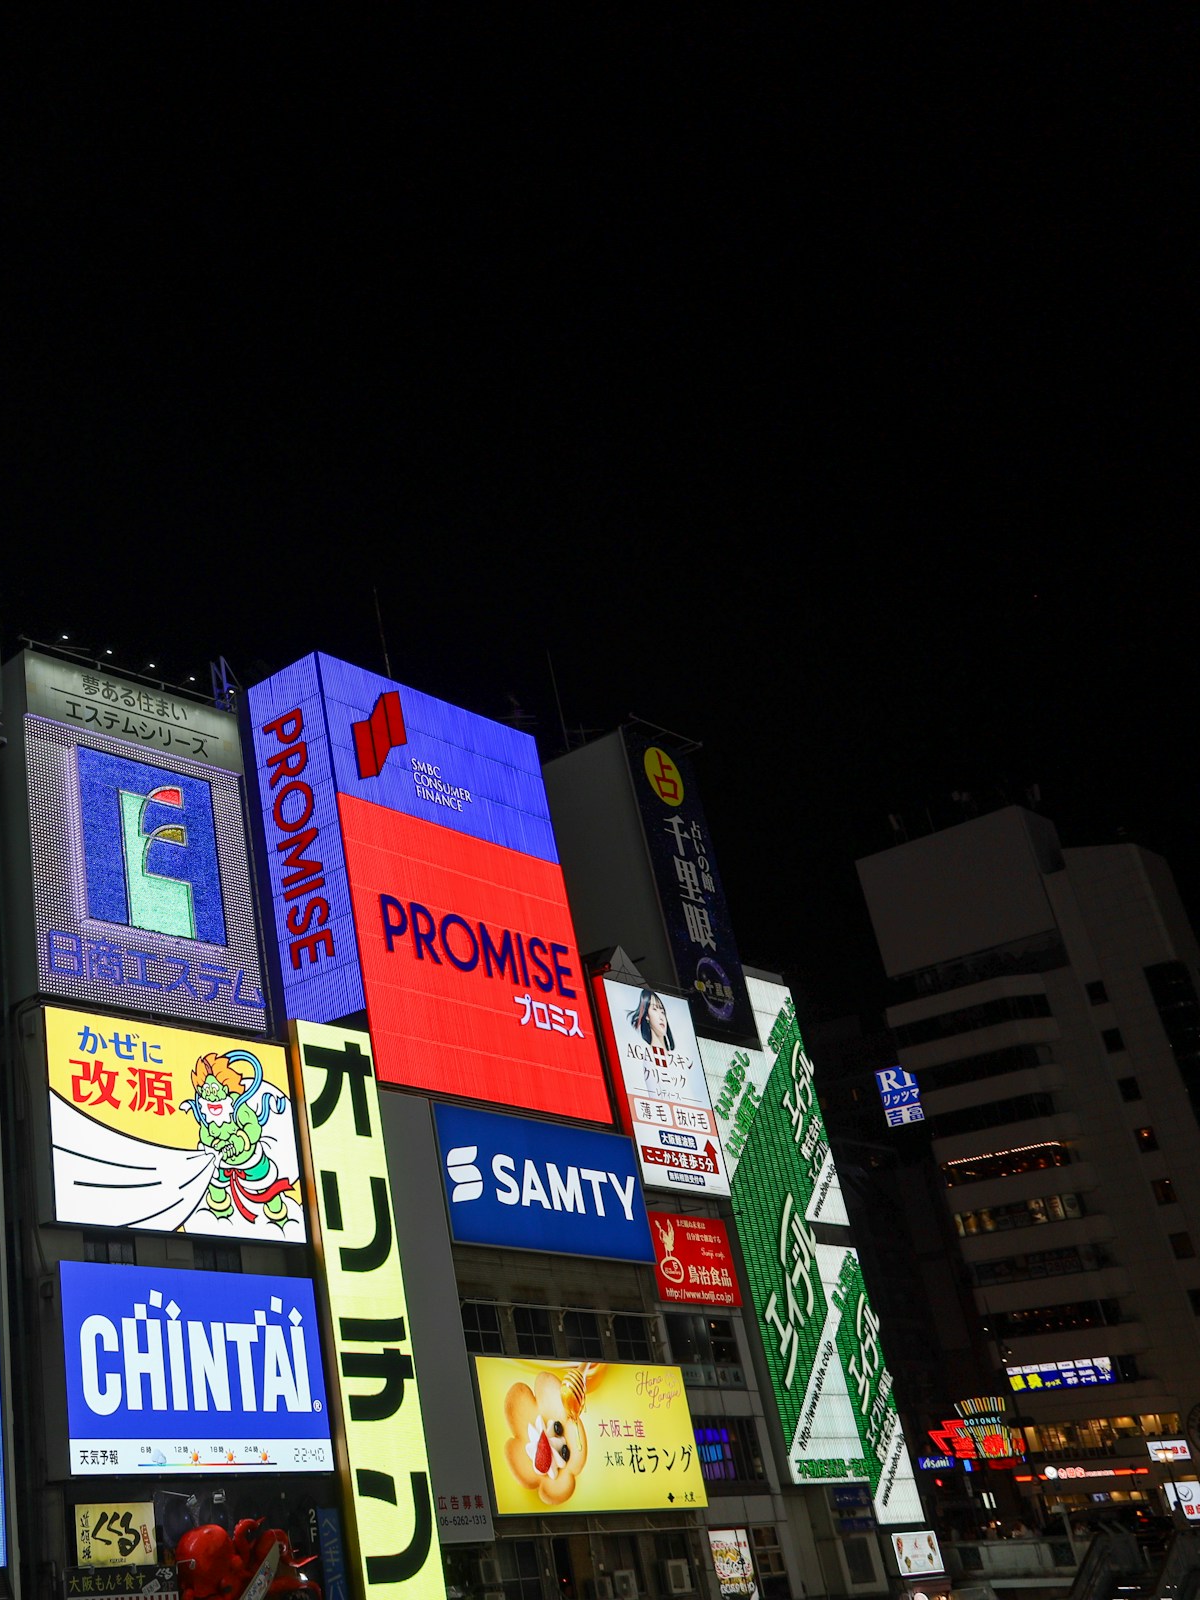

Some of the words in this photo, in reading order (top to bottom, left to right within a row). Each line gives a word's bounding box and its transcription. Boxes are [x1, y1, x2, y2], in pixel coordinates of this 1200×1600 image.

[81, 673, 188, 723] 夢ある住まい
[65, 699, 209, 759] エステムシリーズ
[411, 757, 441, 779] SMBC
[413, 771, 473, 803] CONSUMER
[416, 784, 464, 813] FINANCE
[263, 707, 336, 971] PROMISE
[662, 814, 717, 952] 千里眼
[378, 893, 577, 1000] PROMISE
[48, 929, 267, 1009] 日商エステム
[513, 993, 586, 1040] プロミス
[77, 1025, 164, 1065] かぜに
[626, 1042, 654, 1063] AGA
[667, 1052, 695, 1071] スキン
[68, 1058, 177, 1117] 改源
[642, 1067, 688, 1089] クリニック
[782, 1048, 815, 1128] エイブル
[640, 1101, 667, 1123] 薄毛
[675, 1108, 709, 1132] 抜け毛
[645, 1148, 715, 1173] ここから徒歩5分
[491, 1152, 637, 1222] SAMTY
[687, 1264, 733, 1288] 鳥治食品
[764, 1210, 818, 1360] エイブル
[79, 1288, 313, 1417] CHINTAI
[848, 1301, 881, 1398] エイブル
[598, 1418, 647, 1439] 大阪土産
[79, 1449, 120, 1466] 天気予報
[293, 1447, 326, 1463] 22:40
[437, 1495, 485, 1511] 広告募集
[439, 1514, 487, 1527] 06-6262-1313
